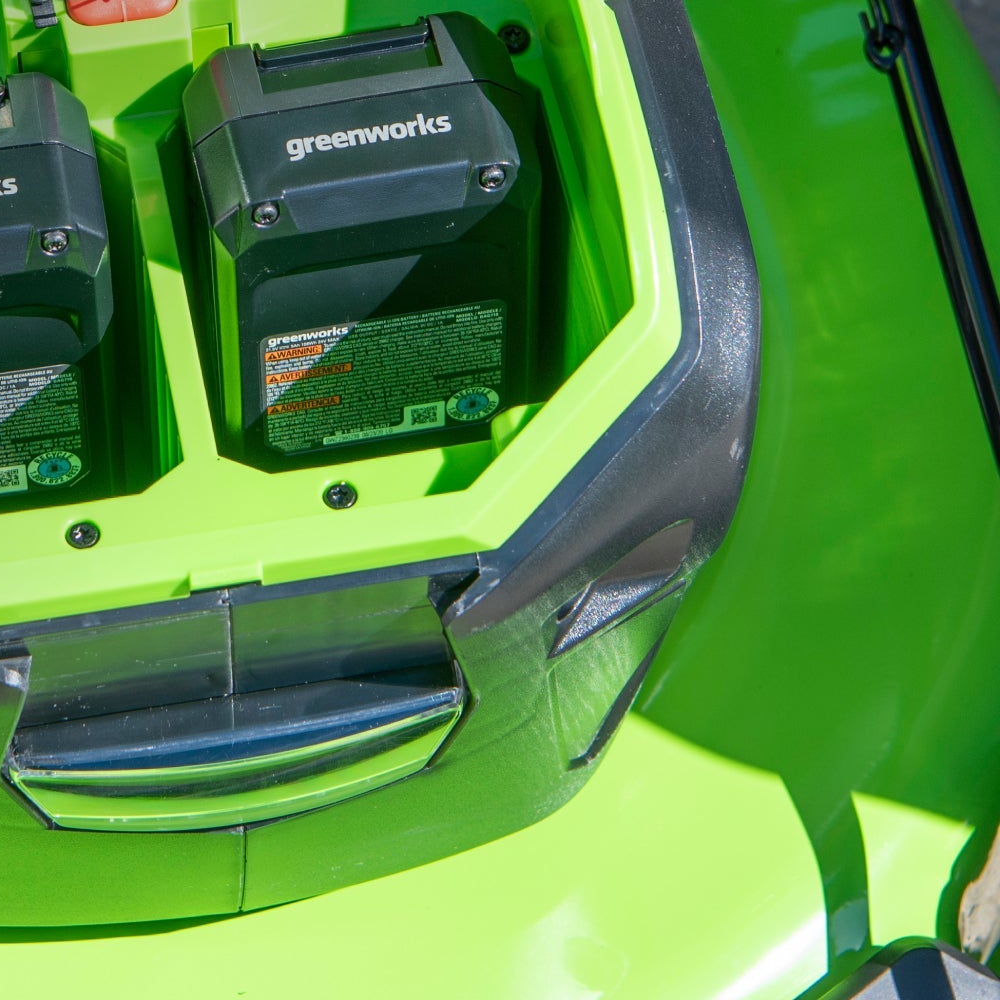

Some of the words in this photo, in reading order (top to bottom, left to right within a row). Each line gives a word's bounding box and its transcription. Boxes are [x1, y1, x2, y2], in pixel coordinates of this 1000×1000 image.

[286, 113, 453, 161] greenworks
[268, 325, 349, 348] greenworks
[454, 387, 493, 399] RECYCLE
[34, 452, 74, 464] RECYCLE
